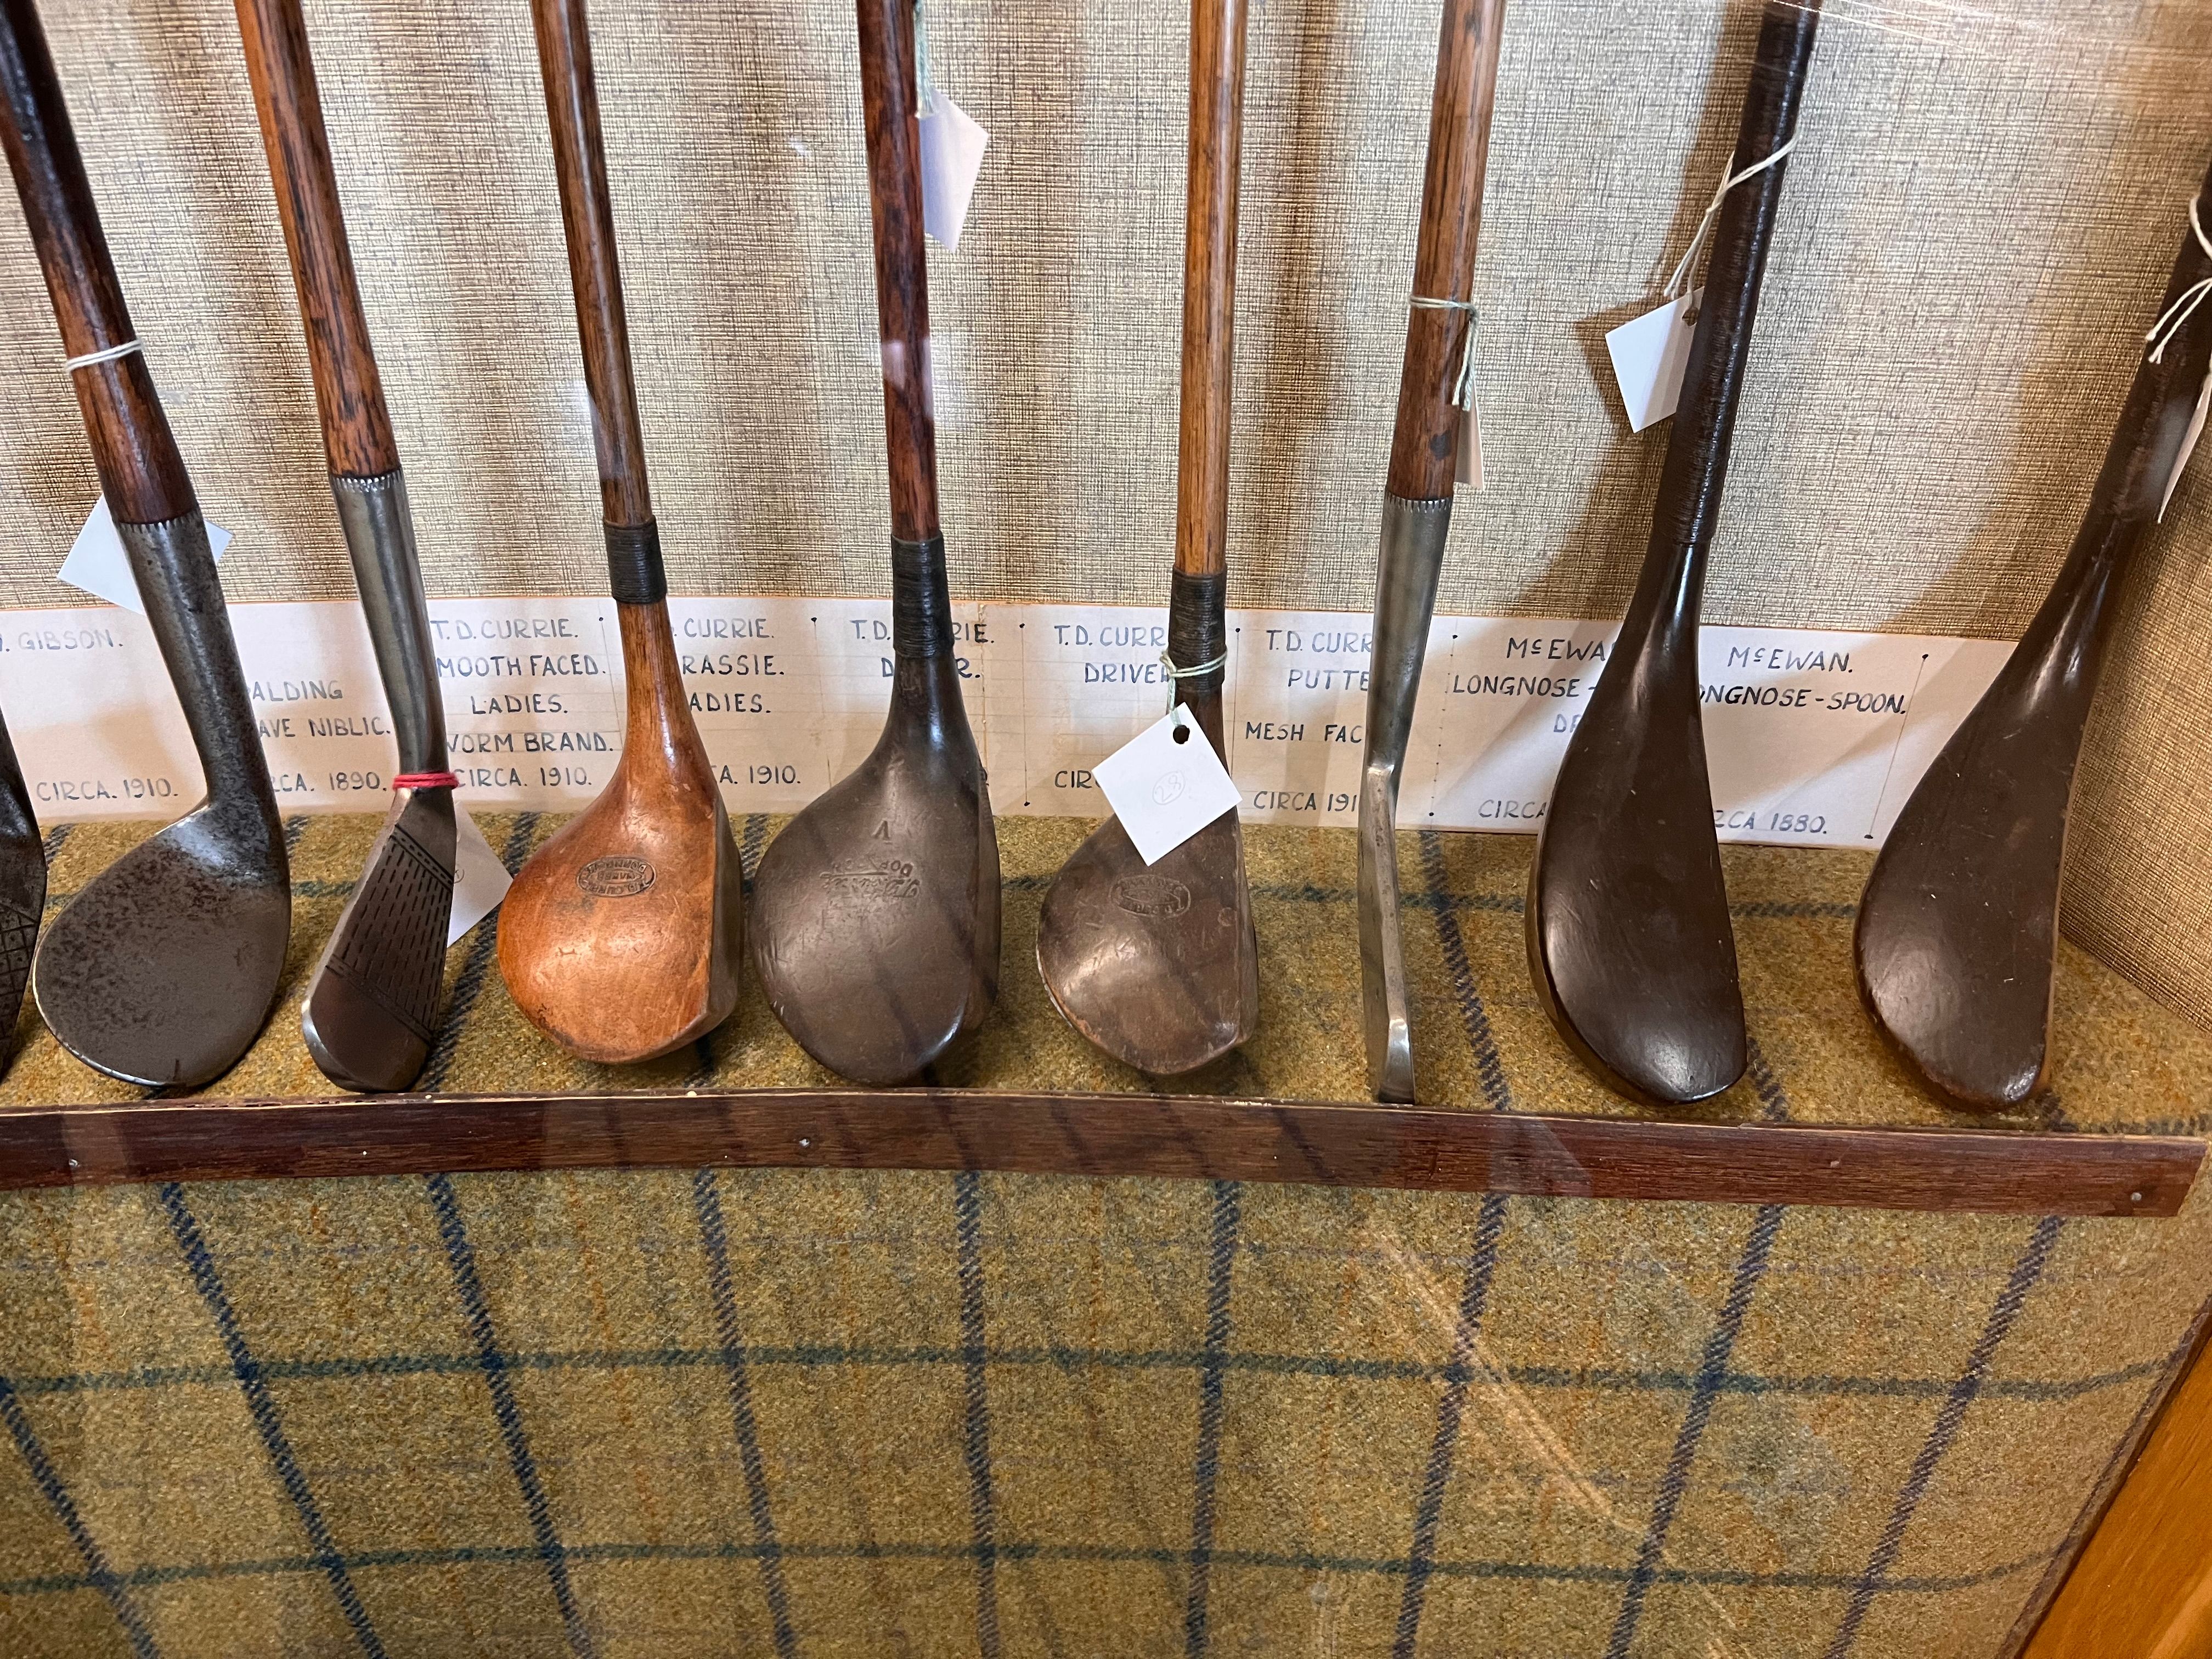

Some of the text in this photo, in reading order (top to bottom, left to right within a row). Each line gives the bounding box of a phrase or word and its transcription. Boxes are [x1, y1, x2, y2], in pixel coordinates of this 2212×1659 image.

[481, 618, 579, 638] CURRIE.
[684, 618, 774, 638] CURRIE.
[1099, 627, 1166, 647] CURR
[18, 629, 123, 650] GIBSON.
[1312, 633, 1372, 653] CURR
[1506, 637, 1616, 661] McEWA
[436, 653, 606, 678] MOOTH FACED.
[682, 654, 785, 675] RASSIE.
[1727, 647, 1853, 673] McEWAN.
[247, 680, 343, 702] ALDING
[1288, 669, 1370, 692] PUTTE
[471, 693, 568, 714] LADIES.
[690, 692, 771, 713] ADIES.
[259, 716, 391, 738] AVE NIBLIC.
[1245, 721, 1363, 743] MESH FAC
[524, 732, 614, 753] BRAND.
[329, 771, 387, 792] 1890.
[540, 766, 592, 786] 1910.
[749, 765, 801, 785] 1910.
[1054, 770, 1101, 789] CIR
[37, 777, 179, 802] CIRCA. 1910.
[1254, 791, 1357, 812] CIRCA 191
[1770, 812, 1827, 834] 1880.
